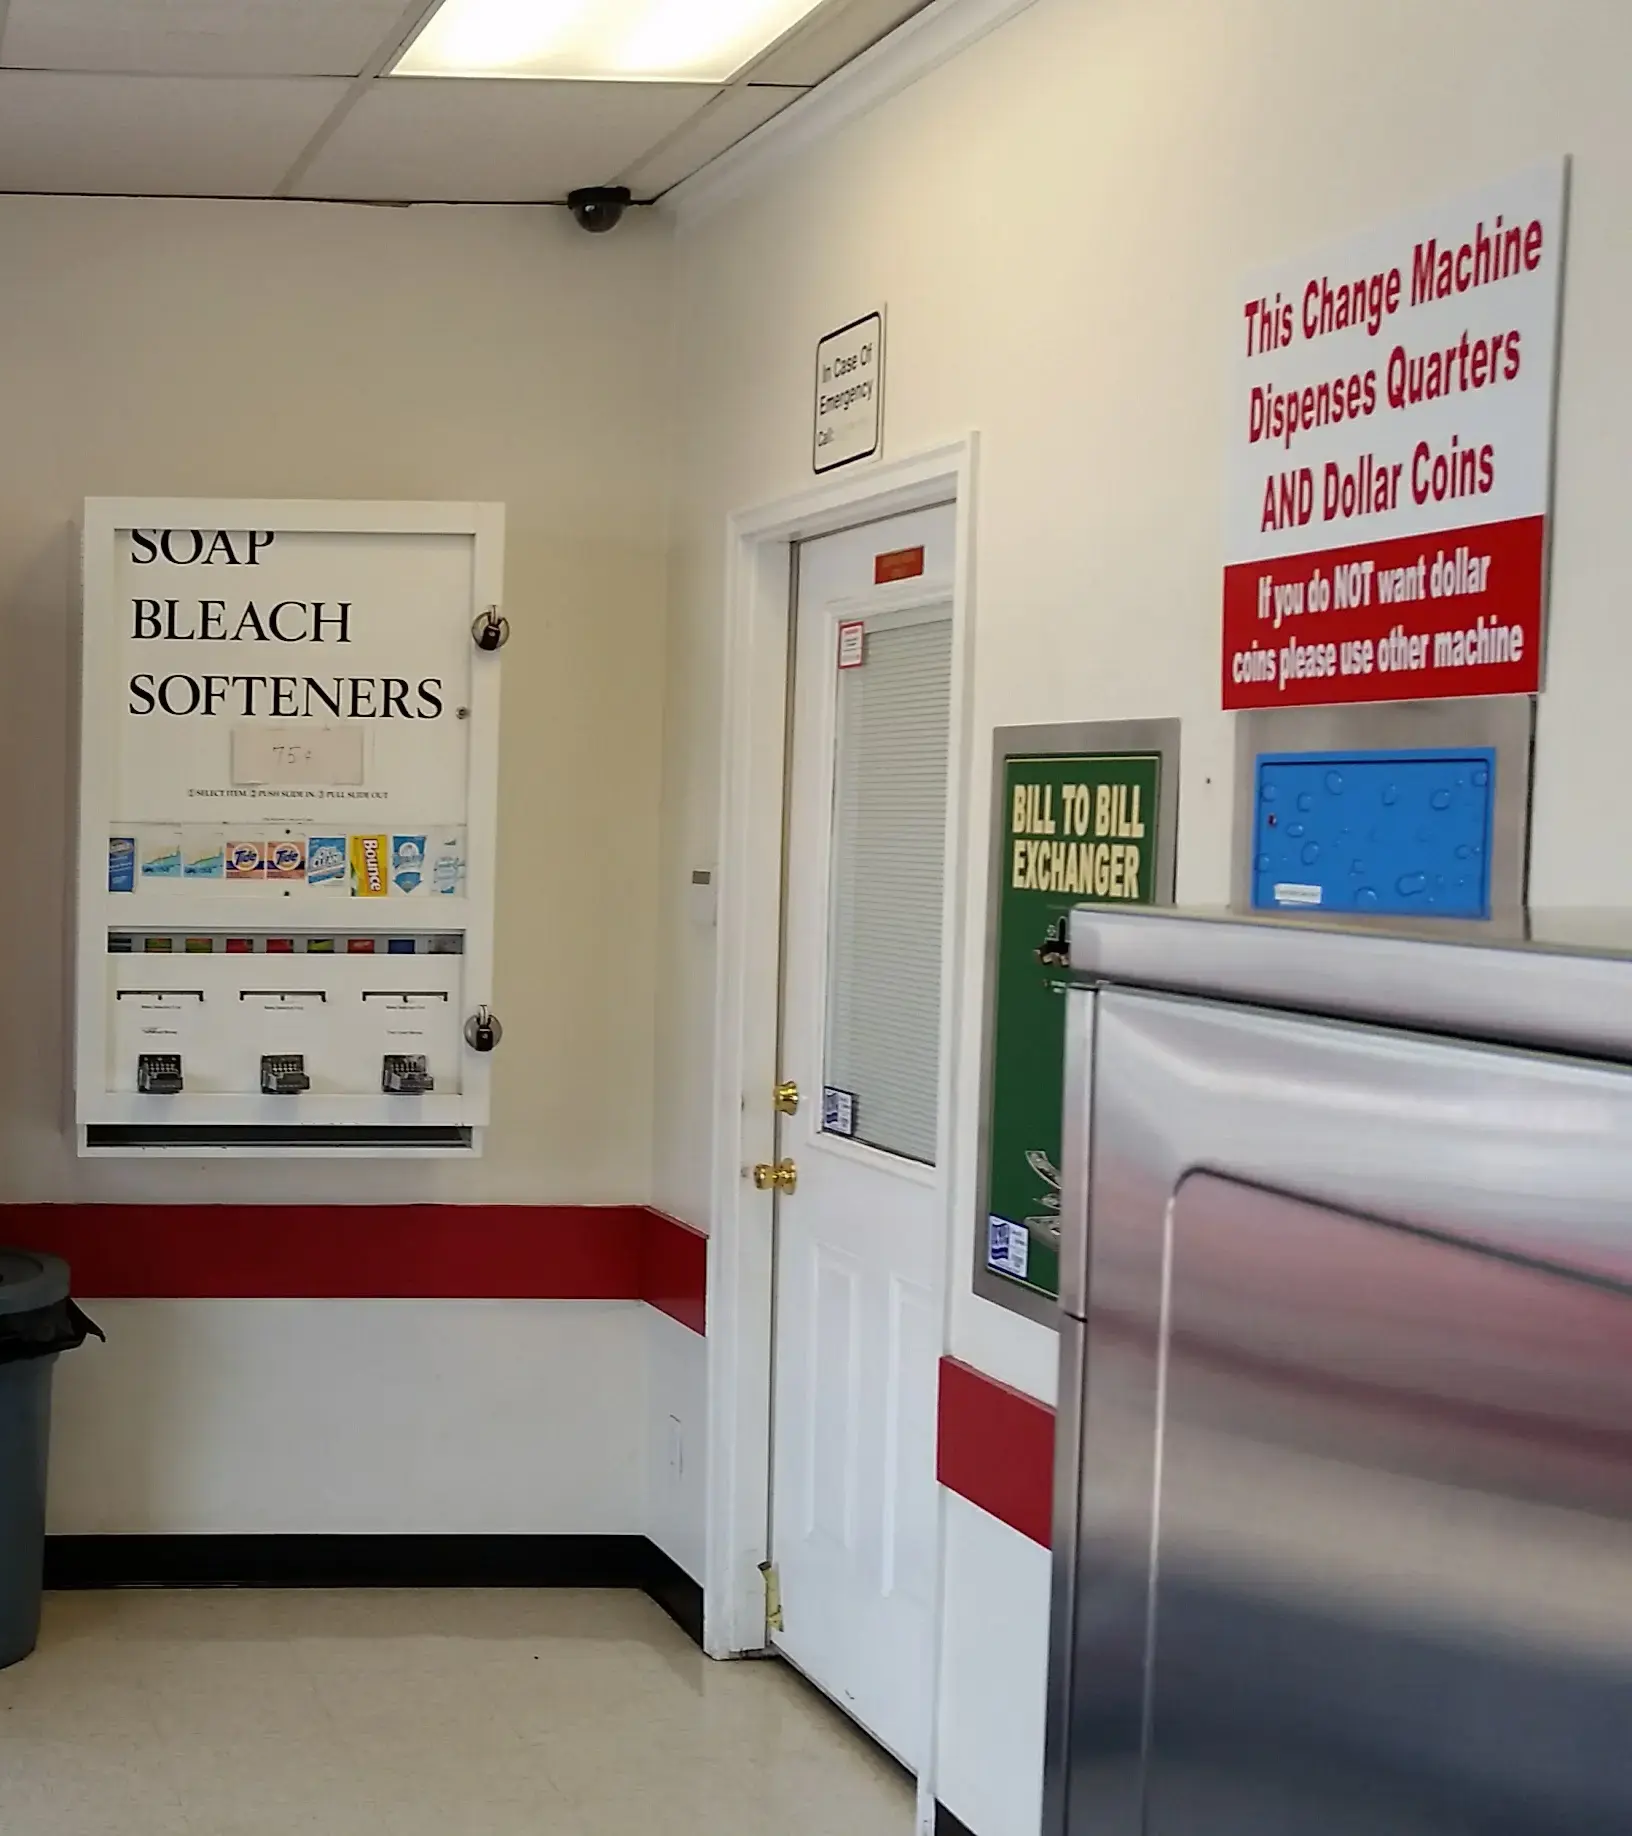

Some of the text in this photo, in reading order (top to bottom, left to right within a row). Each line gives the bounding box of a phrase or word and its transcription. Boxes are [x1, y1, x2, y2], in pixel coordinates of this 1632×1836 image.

[1244, 215, 1543, 357] This Change Machine
[822, 343, 872, 383] In Case Of
[820, 379, 874, 415] Emergency
[1249, 329, 1521, 450] Dispenses Quarters
[1260, 435, 1495, 532] AND Dollar Coins
[130, 528, 275, 566] SOAP
[1257, 546, 1492, 628] If you do NOT want dollar
[130, 598, 353, 644] BLEACH
[1232, 614, 1525, 690] coins please use other machine
[128, 673, 444, 720] SOFTENERS
[196, 789, 224, 797] SELECT
[226, 789, 247, 797] ITEM
[1012, 783, 1145, 838] BILL TO BILL
[235, 850, 258, 865] Tide
[276, 850, 298, 865] Tide
[362, 839, 382, 892] Bounce
[1012, 840, 1139, 899] EXCHANGER
